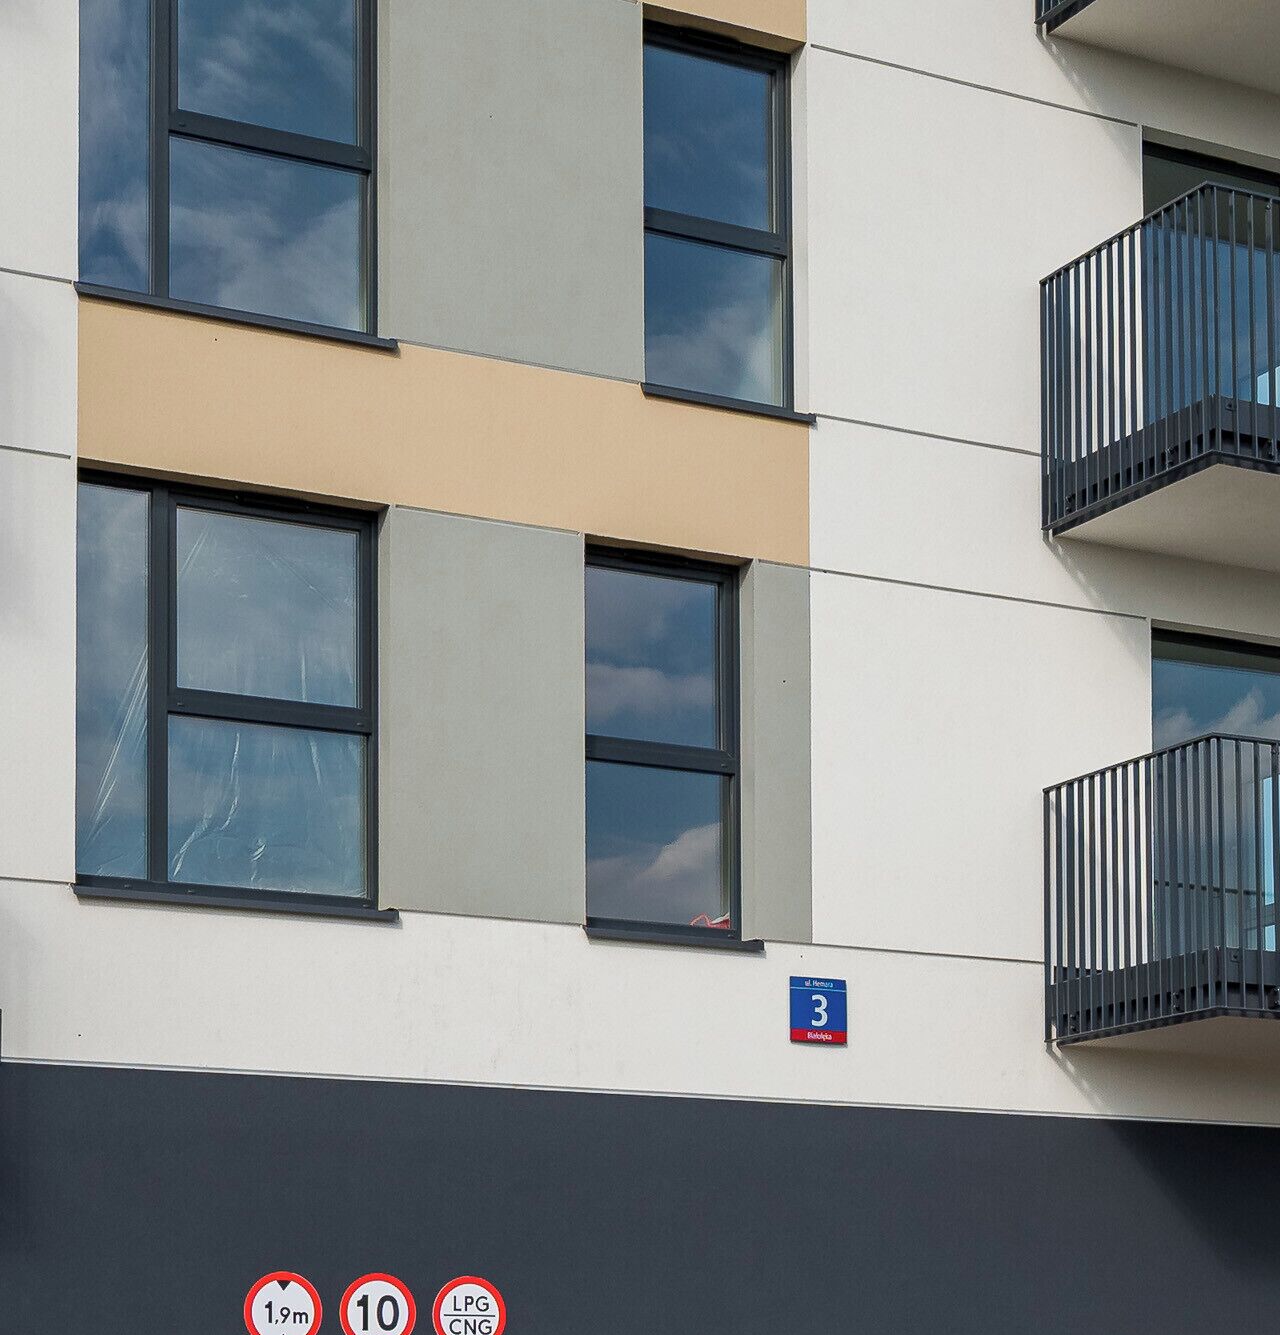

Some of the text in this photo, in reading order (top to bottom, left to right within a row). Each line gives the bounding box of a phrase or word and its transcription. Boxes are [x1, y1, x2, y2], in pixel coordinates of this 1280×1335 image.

[811, 994, 828, 1026] 3
[264, 1300, 309, 1325] 1,9m
[356, 1294, 400, 1332] 10
[453, 1295, 490, 1312] LPG
[449, 1318, 493, 1335] CNG
